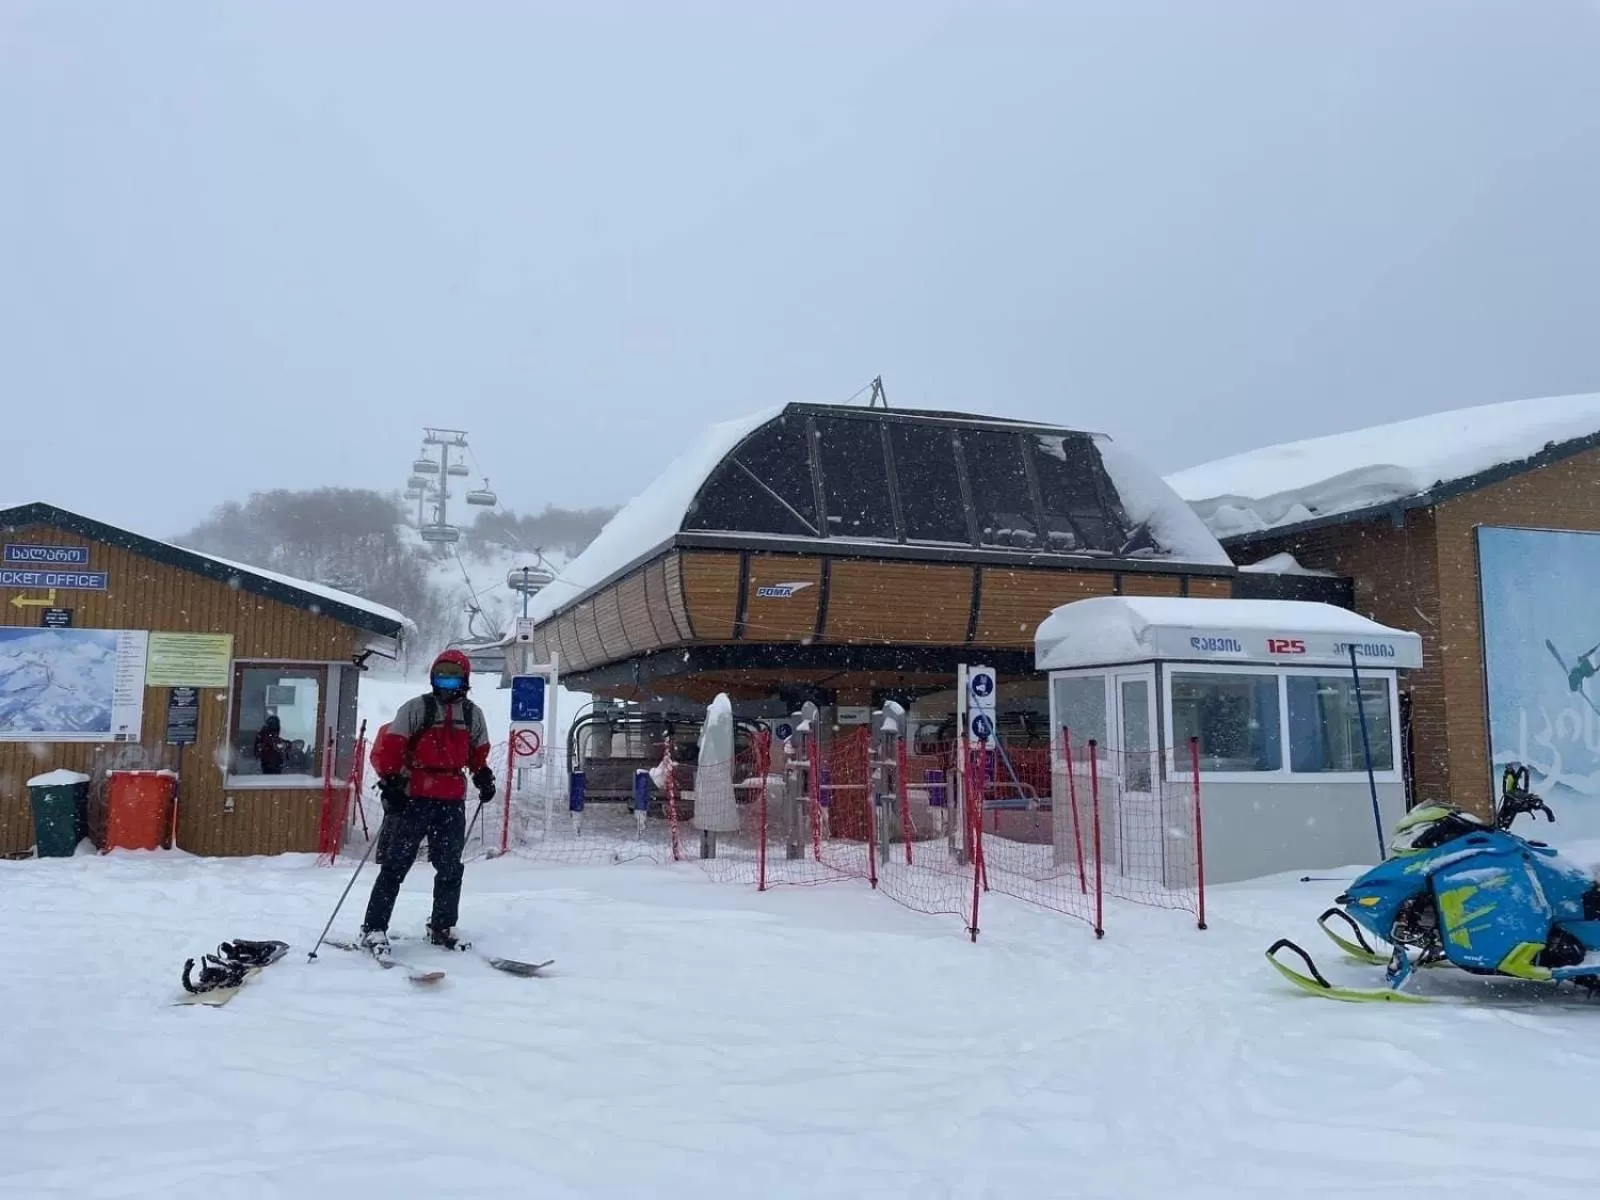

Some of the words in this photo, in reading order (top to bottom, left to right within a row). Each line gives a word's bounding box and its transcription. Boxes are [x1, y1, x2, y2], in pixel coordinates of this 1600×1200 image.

[12, 547, 80, 561] სალარო
[46, 573, 99, 587] OFFICE
[758, 587, 791, 597] POMA
[1267, 638, 1306, 655] 125
